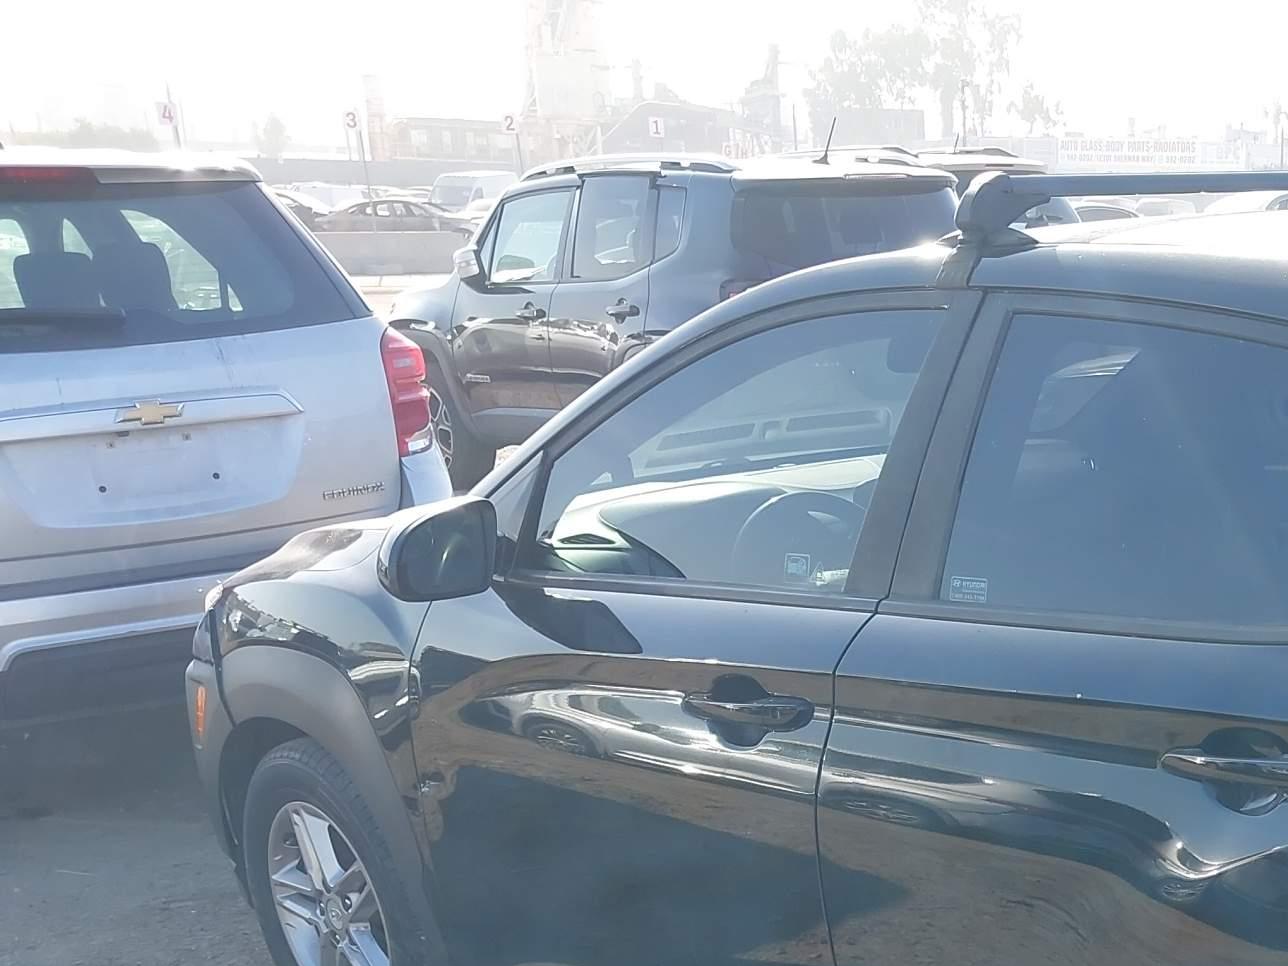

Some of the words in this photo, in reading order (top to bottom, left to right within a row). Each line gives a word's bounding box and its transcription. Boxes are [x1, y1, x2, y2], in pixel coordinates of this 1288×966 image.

[161, 104, 174, 123] 4
[345, 111, 359, 129] 3
[503, 115, 516, 131] 2
[651, 119, 662, 134] 1
[323, 481, 385, 500] EQUINOX
